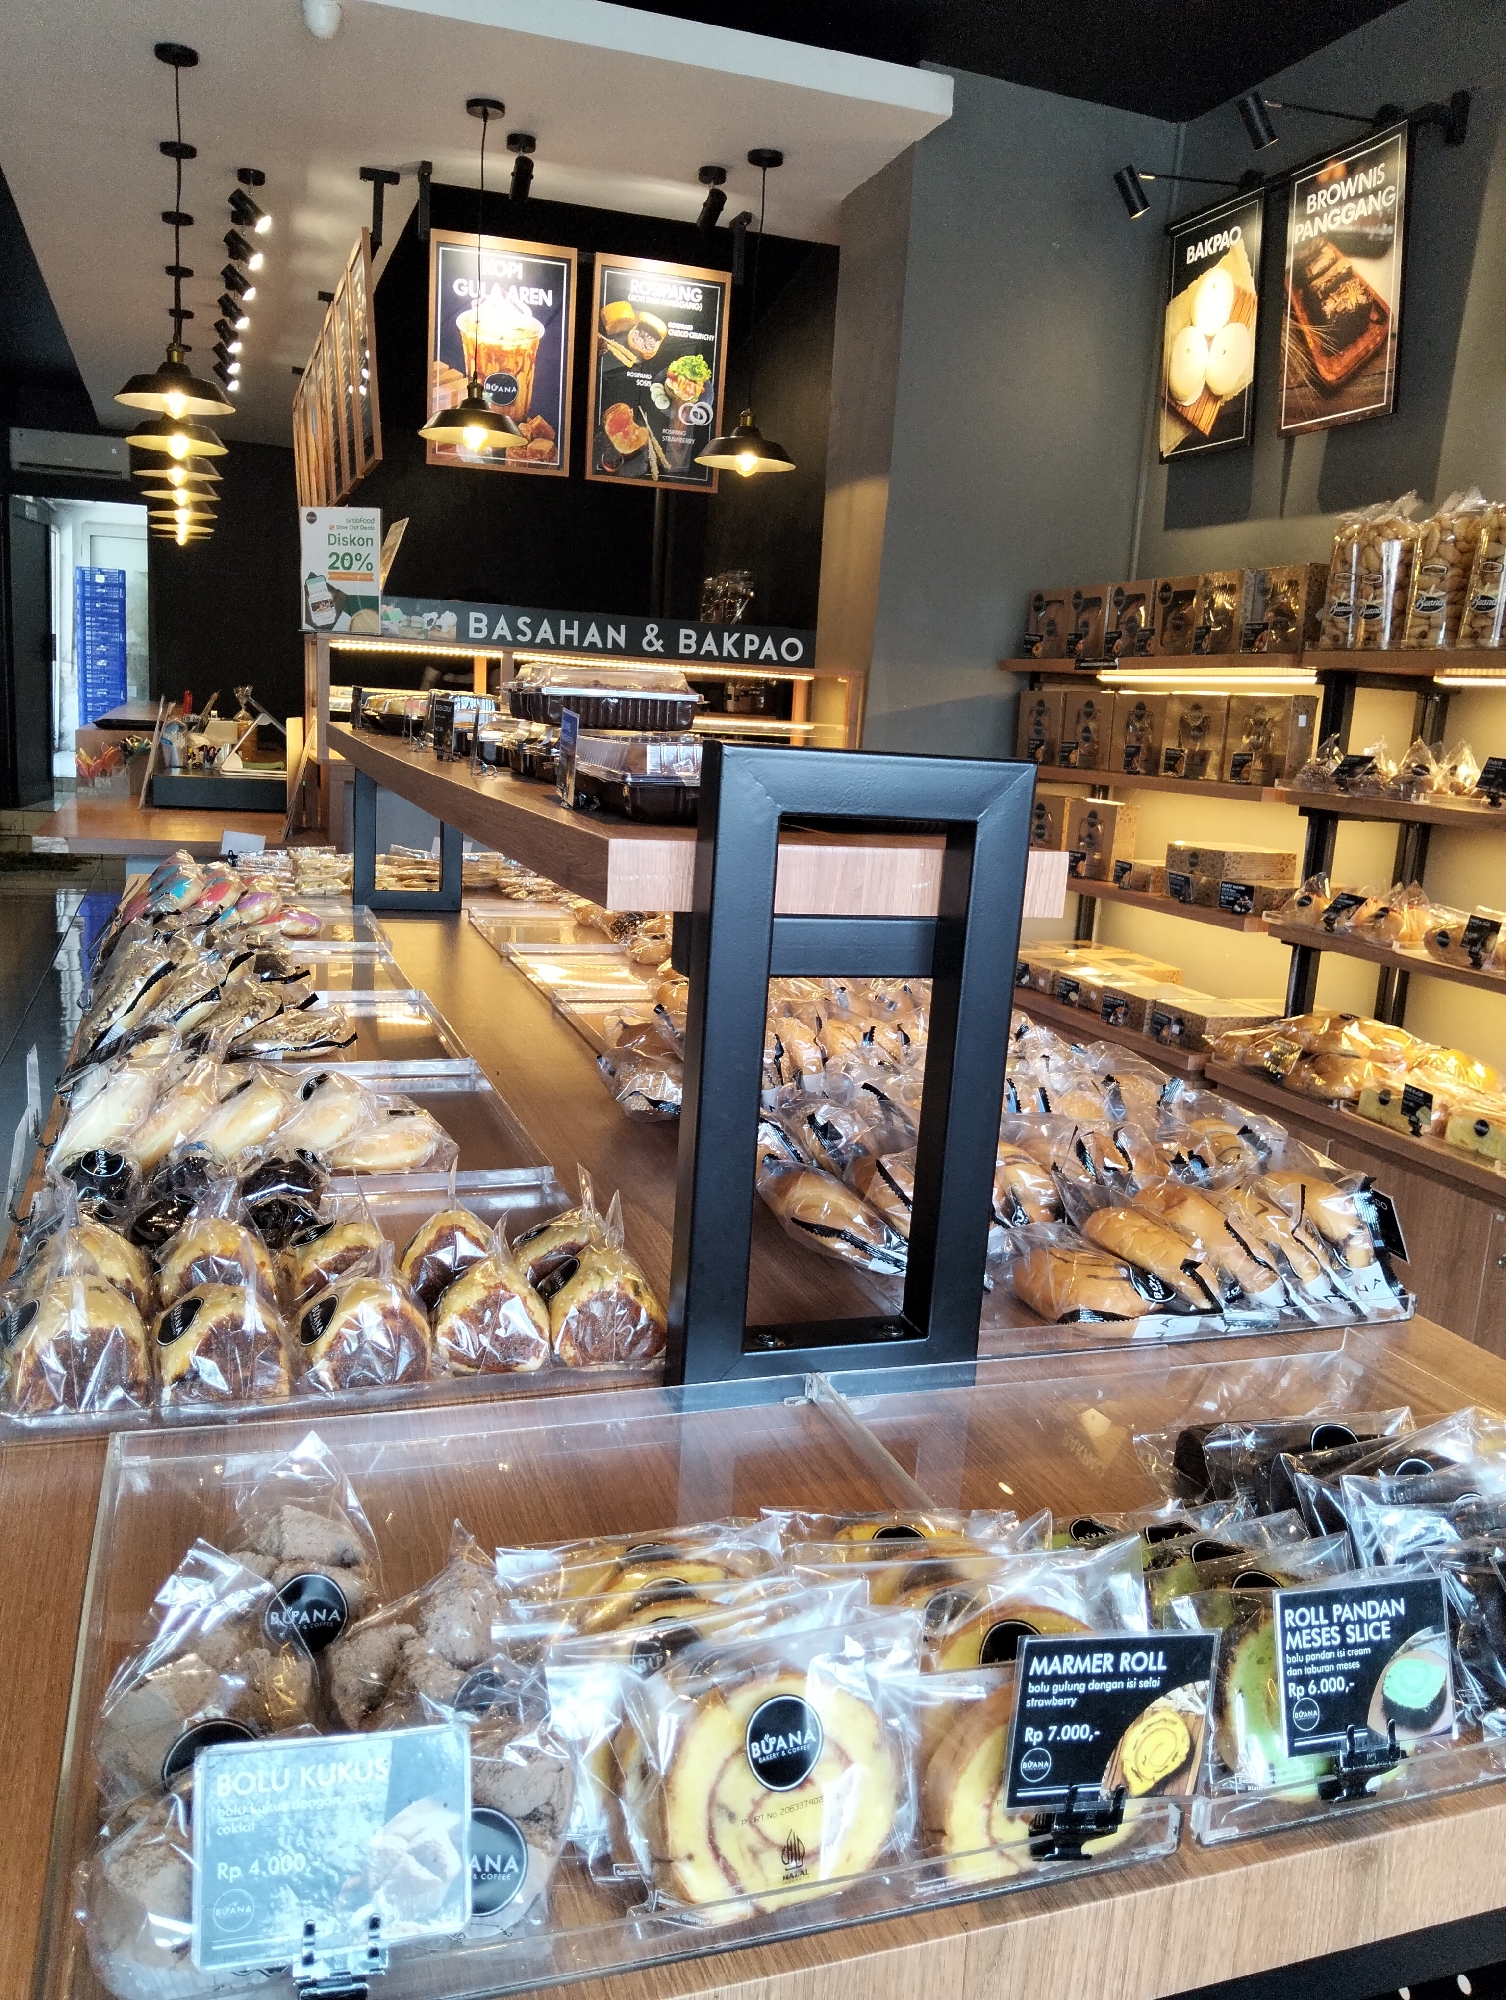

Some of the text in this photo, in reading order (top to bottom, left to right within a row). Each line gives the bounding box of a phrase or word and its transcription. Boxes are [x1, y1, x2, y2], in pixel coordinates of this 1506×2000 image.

[1306, 162, 1386, 214] BROWNIS
[1294, 185, 1396, 244] PANGGANG
[1186, 225, 1242, 264] BAKPAO
[481, 259, 523, 280] KOPI
[453, 278, 553, 307] GULA AREN
[485, 383, 517, 393] BUANA
[327, 533, 374, 547] Diskon
[327, 551, 374, 571] 20%
[468, 612, 804, 662] BASAHAN & BAKPAO
[270, 1608, 341, 1626] BUANA
[1284, 1597, 1406, 1628] ROLL PANDAN
[1285, 1620, 1391, 1650] MESES SLICE
[1028, 1651, 1167, 1676] MARMER ROLL
[1286, 1648, 1371, 1664] bolu pandan isi cream
[1287, 1661, 1360, 1676] dan taburan meses
[1028, 1676, 1161, 1695] bolu gulung dengan isi selai
[1288, 1676, 1355, 1700] Rp 6.000,-
[1025, 1695, 1078, 1708] strawberry
[750, 1728, 817, 1759] BUANA
[1024, 1723, 1101, 1746] Rp 7.000,-
[758, 1752, 779, 1764] BAKERY
[787, 1743, 811, 1755] COFFEE
[1022, 1760, 1049, 1769] BUANA
[216, 1757, 389, 1798] BOLU KUKUS
[217, 1803, 246, 1817] bolu
[216, 1822, 256, 1836] coklat
[217, 1861, 242, 1884] Rp
[480, 1873, 511, 1881] COFFEE
[215, 1904, 252, 1917] BUANA
